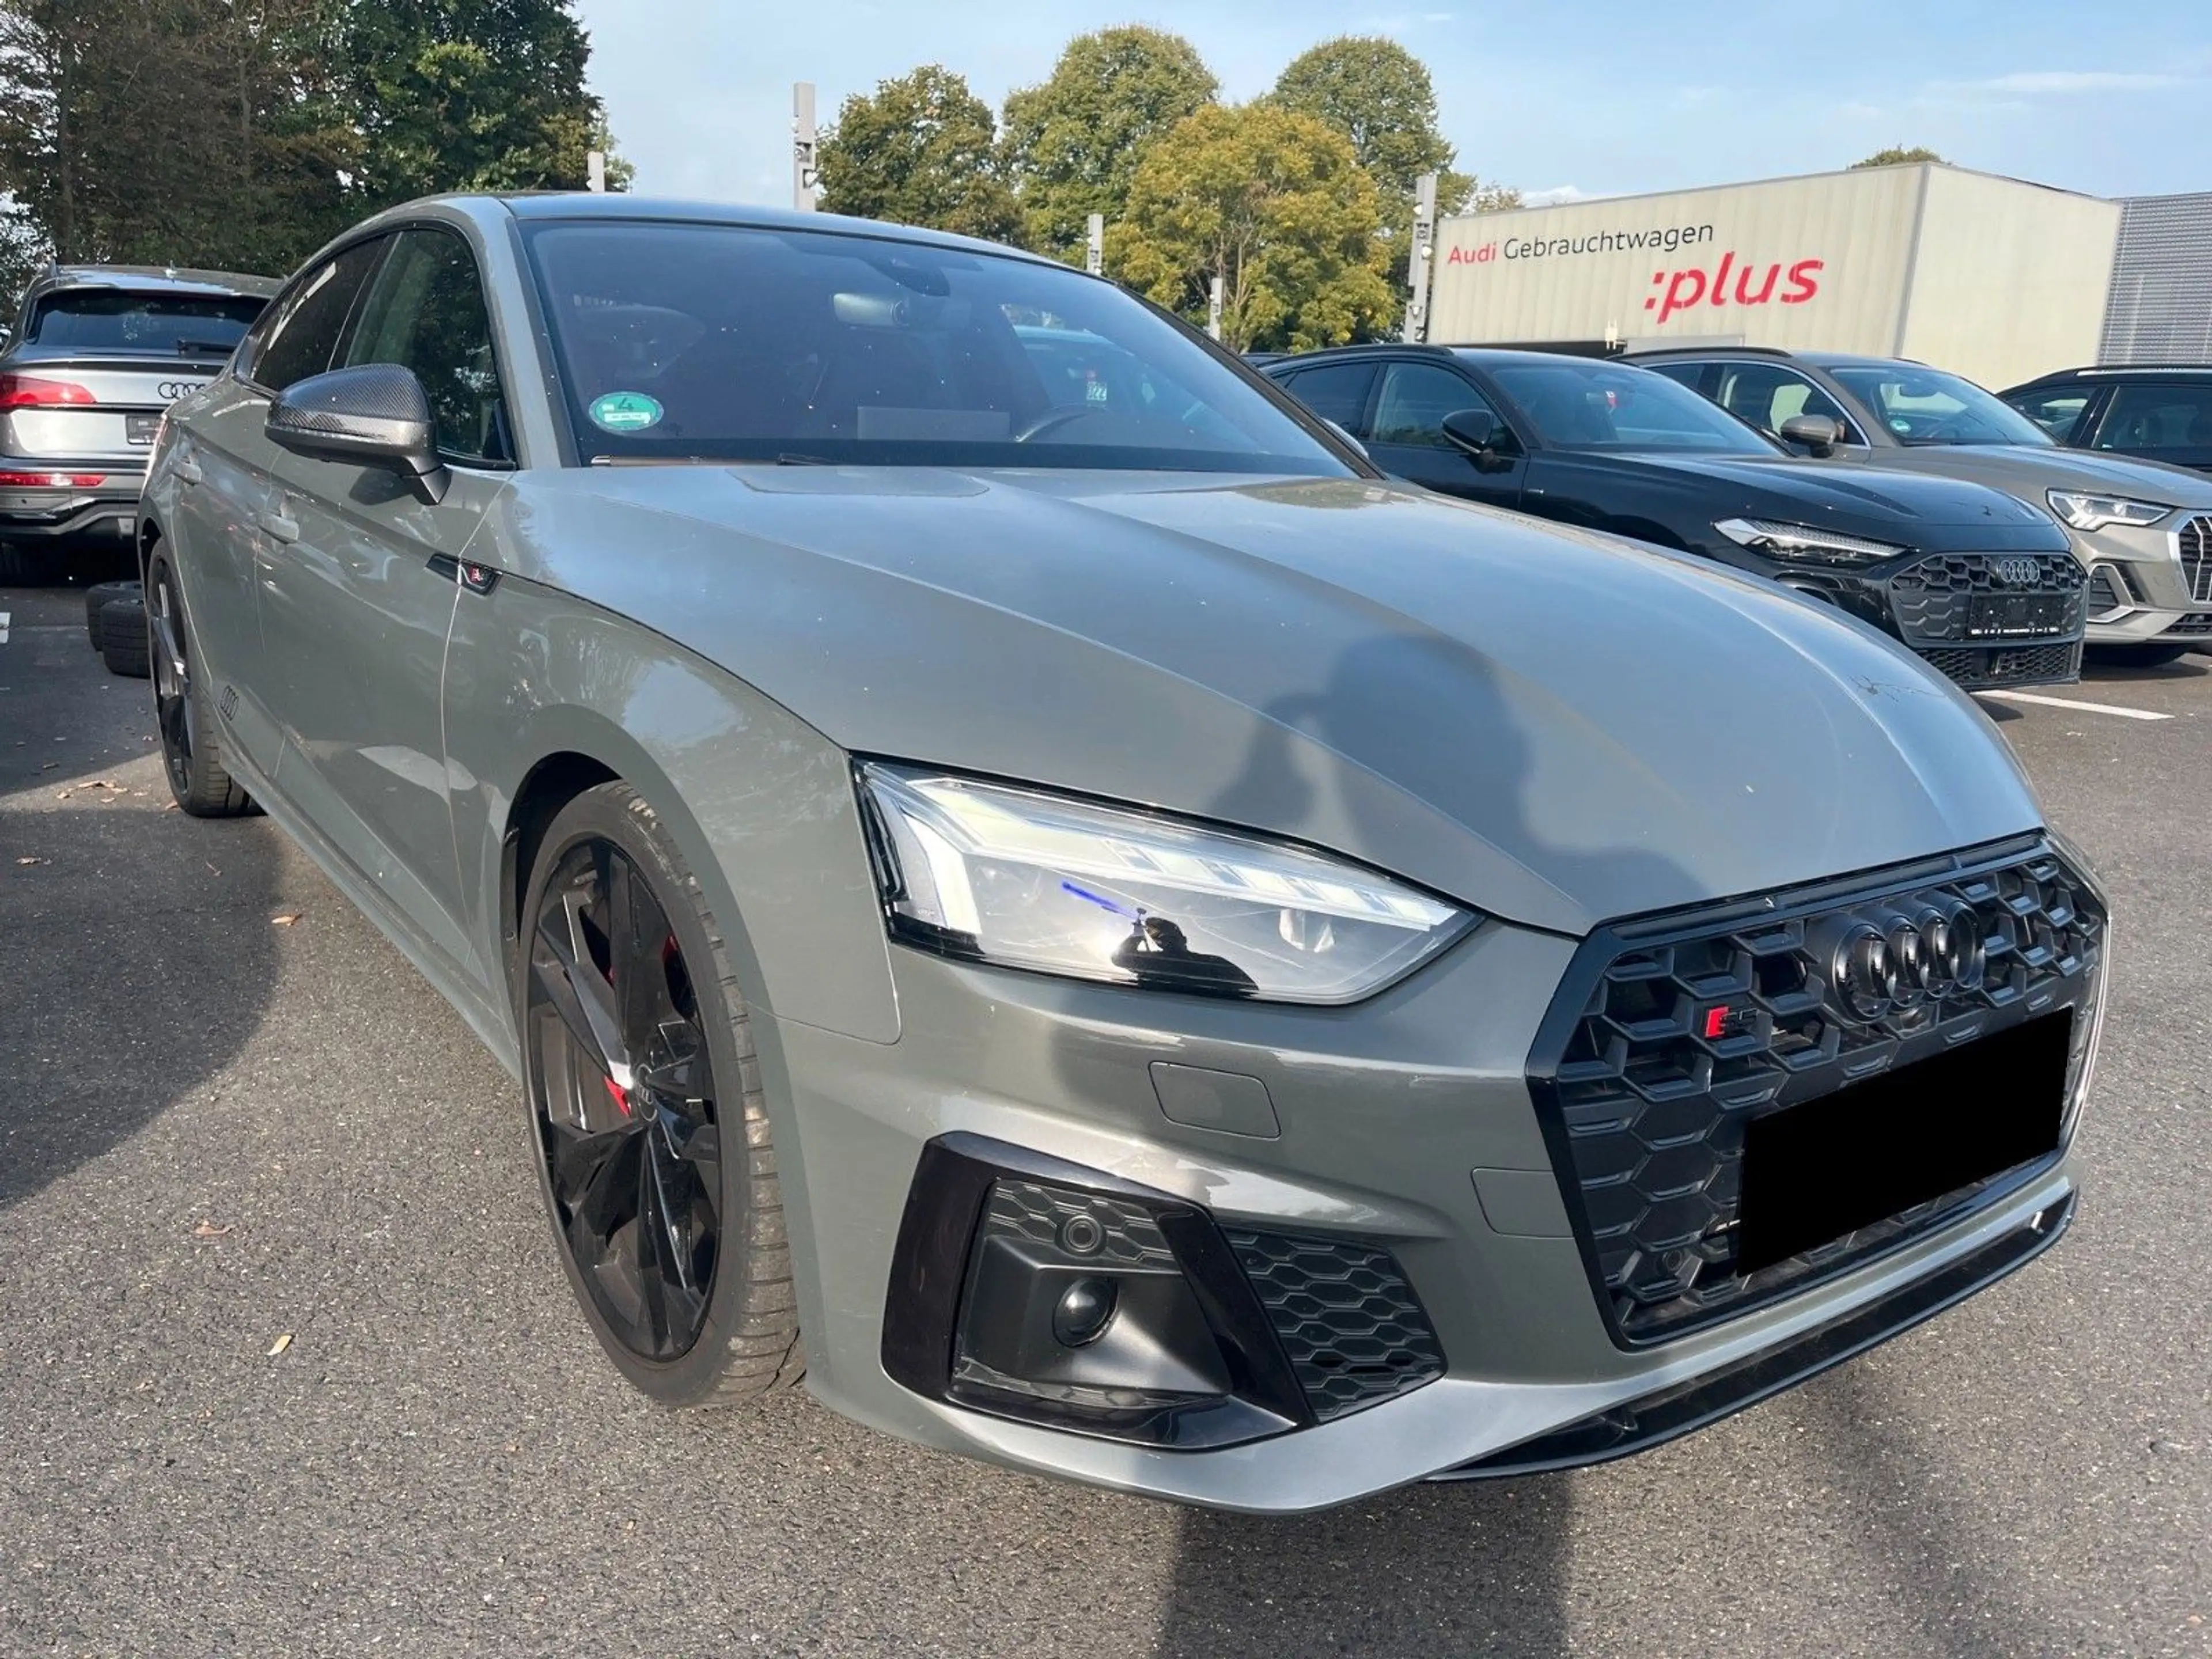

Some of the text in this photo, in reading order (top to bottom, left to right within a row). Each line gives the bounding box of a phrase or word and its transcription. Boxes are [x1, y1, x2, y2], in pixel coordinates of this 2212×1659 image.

[1448, 225, 1713, 264] Audi Gebrauchtwagen
[1644, 251, 1824, 324] :plus
[618, 397, 634, 411] 4
